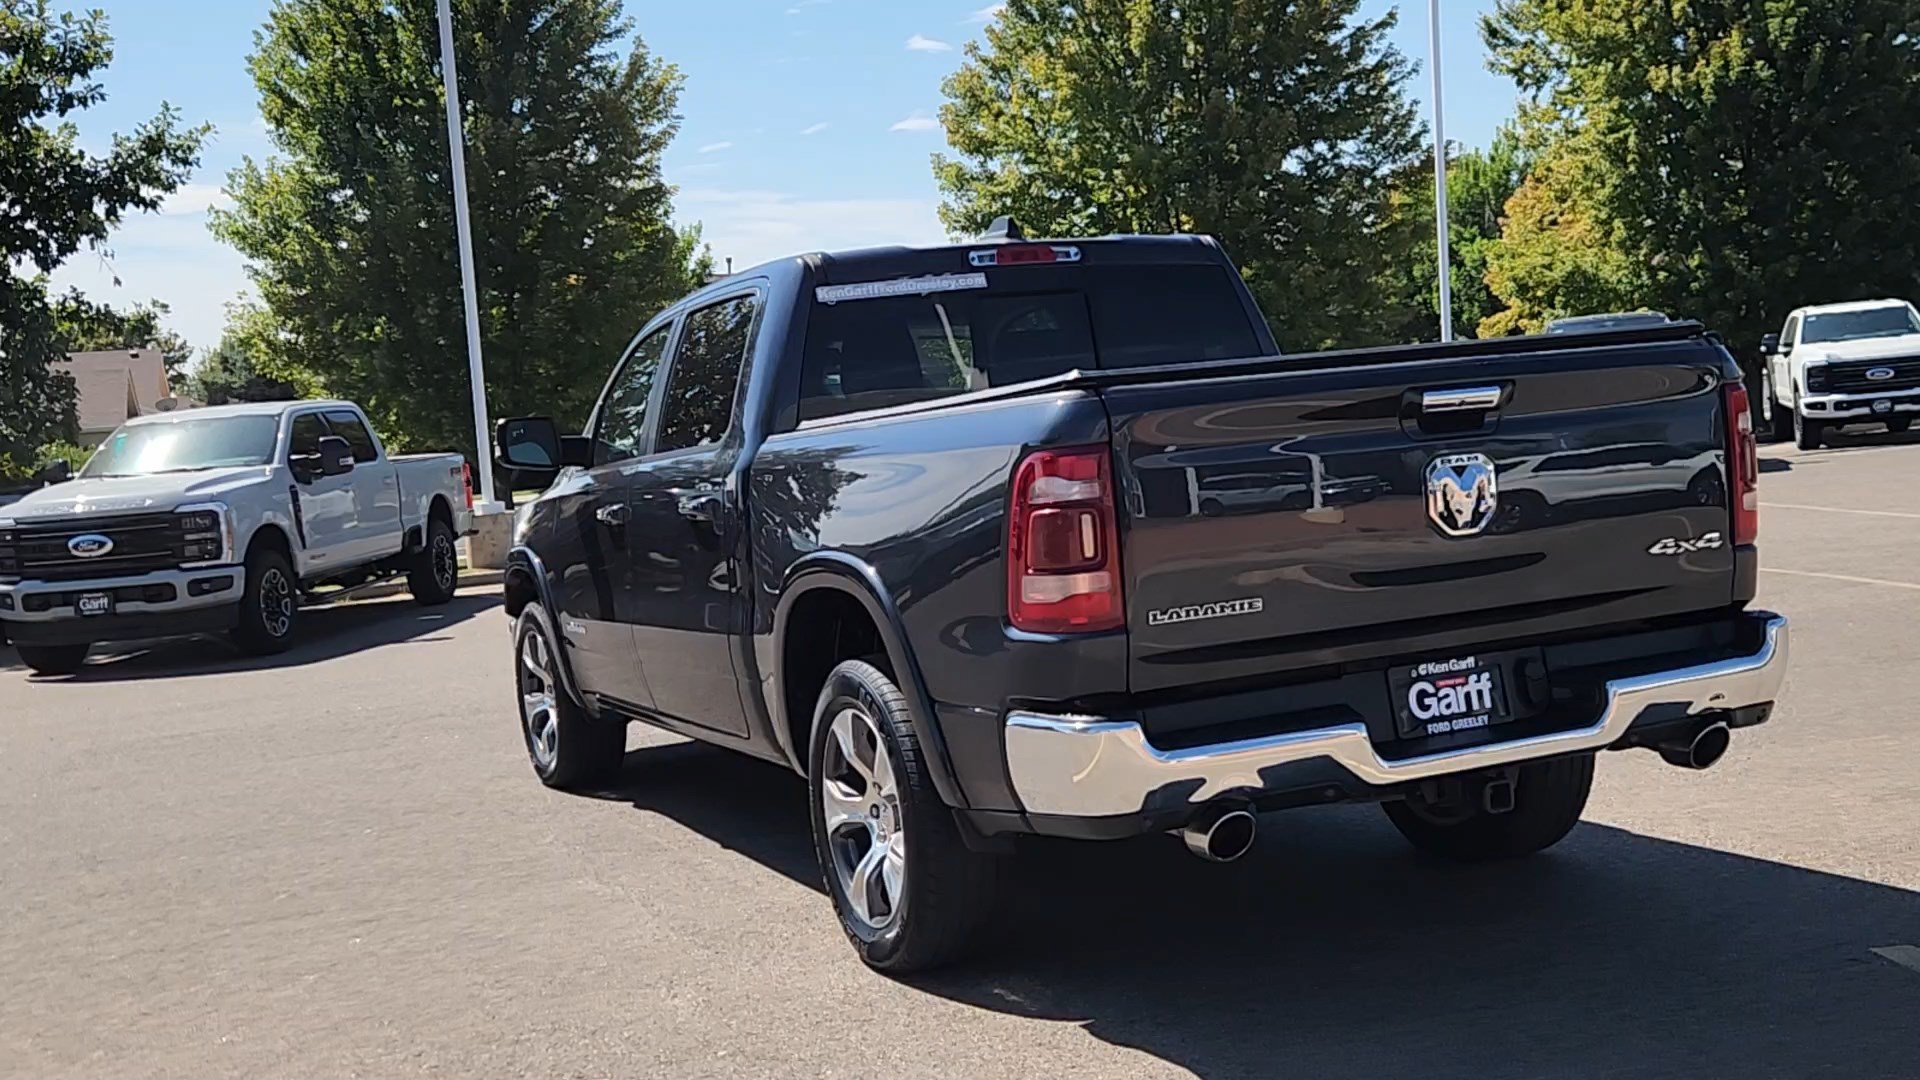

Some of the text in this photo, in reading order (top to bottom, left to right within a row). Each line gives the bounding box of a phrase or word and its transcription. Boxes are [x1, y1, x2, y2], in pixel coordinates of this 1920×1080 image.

[1440, 455, 1479, 465] RAM
[79, 597, 109, 611] Garff
[1149, 598, 1263, 625] LARAMIE
[1427, 656, 1476, 675] Ken Garff
[1408, 672, 1493, 720] Garff
[1426, 714, 1490, 735] FORD GREELEY
